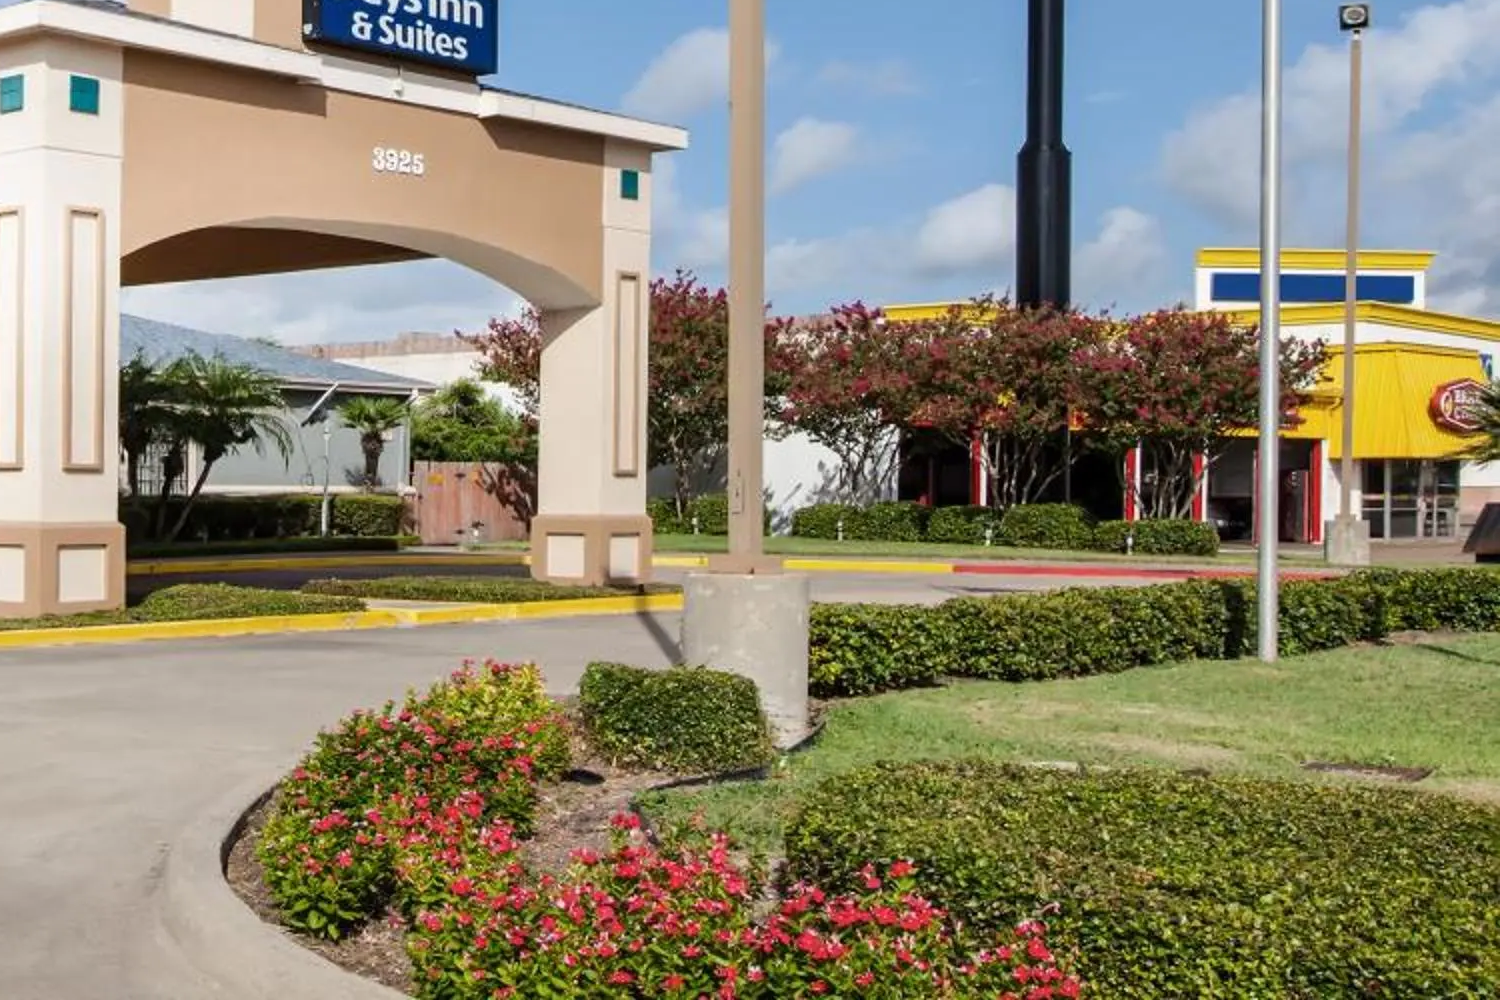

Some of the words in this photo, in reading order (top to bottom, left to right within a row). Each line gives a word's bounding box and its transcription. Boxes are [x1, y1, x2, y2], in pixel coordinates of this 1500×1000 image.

[351, 11, 373, 41] &
[379, 15, 468, 60] Suites
[372, 146, 425, 175] 3925
